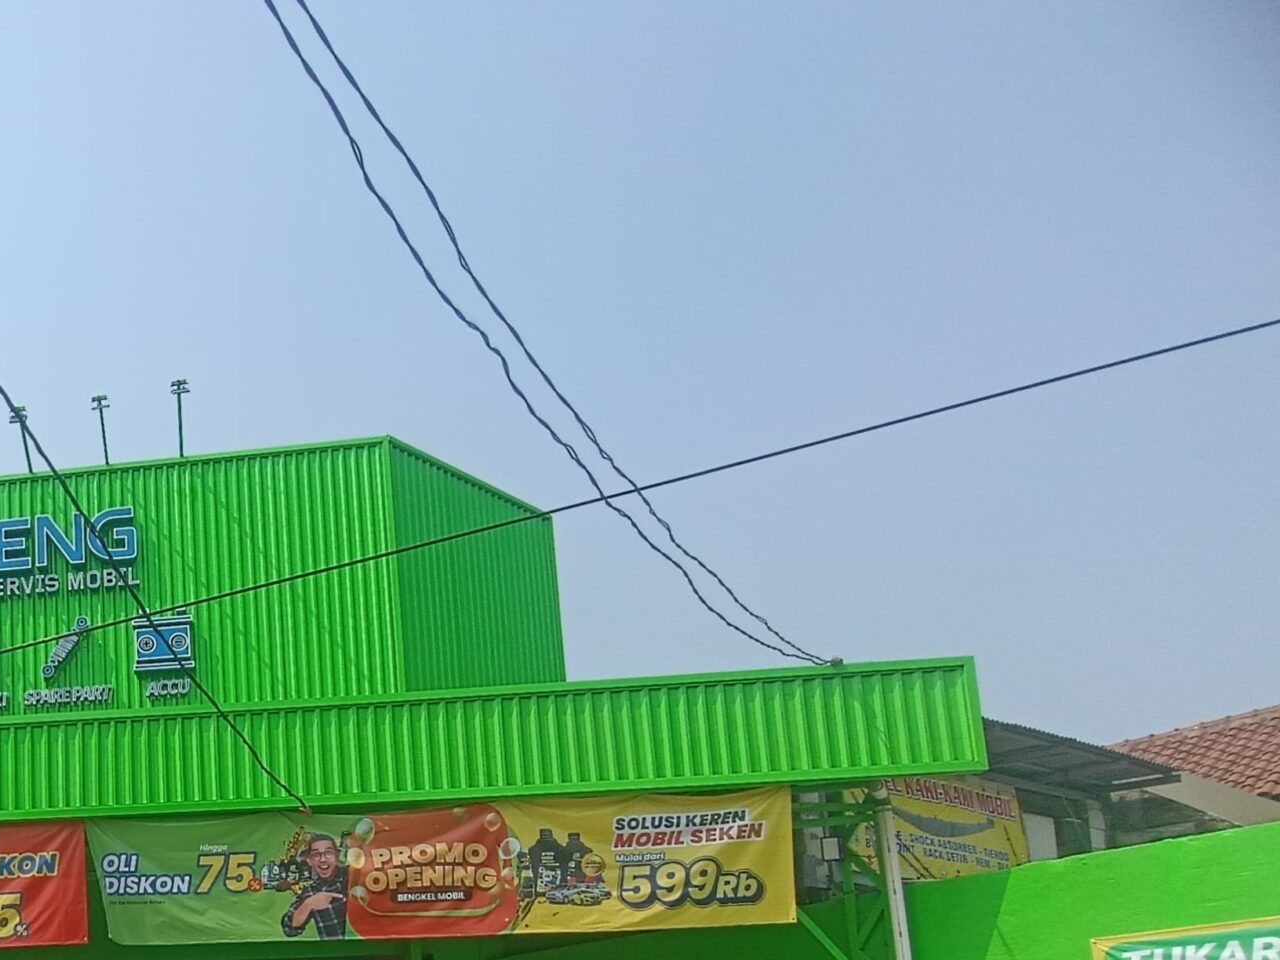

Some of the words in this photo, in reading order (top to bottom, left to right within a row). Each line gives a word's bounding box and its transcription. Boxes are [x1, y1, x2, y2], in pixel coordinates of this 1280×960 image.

[67, 567, 140, 591] MOBIL
[24, 687, 71, 705] SPARE
[72, 684, 114, 702] PART
[145, 679, 191, 697] ACCU
[614, 814, 681, 831] SOLUSI
[685, 810, 746, 828] KEREN
[613, 830, 685, 849] MOBIL
[690, 823, 764, 844] SEKEN
[200, 844, 228, 853] Hingga
[371, 843, 488, 868] PROMO
[615, 853, 643, 862] Mulai
[644, 852, 665, 861] dari
[102, 853, 138, 872] OLI
[104, 875, 191, 895] DISKON
[365, 866, 497, 892] OPENING
[397, 893, 437, 902] BENGKEL
[437, 891, 466, 900] MOBIL
